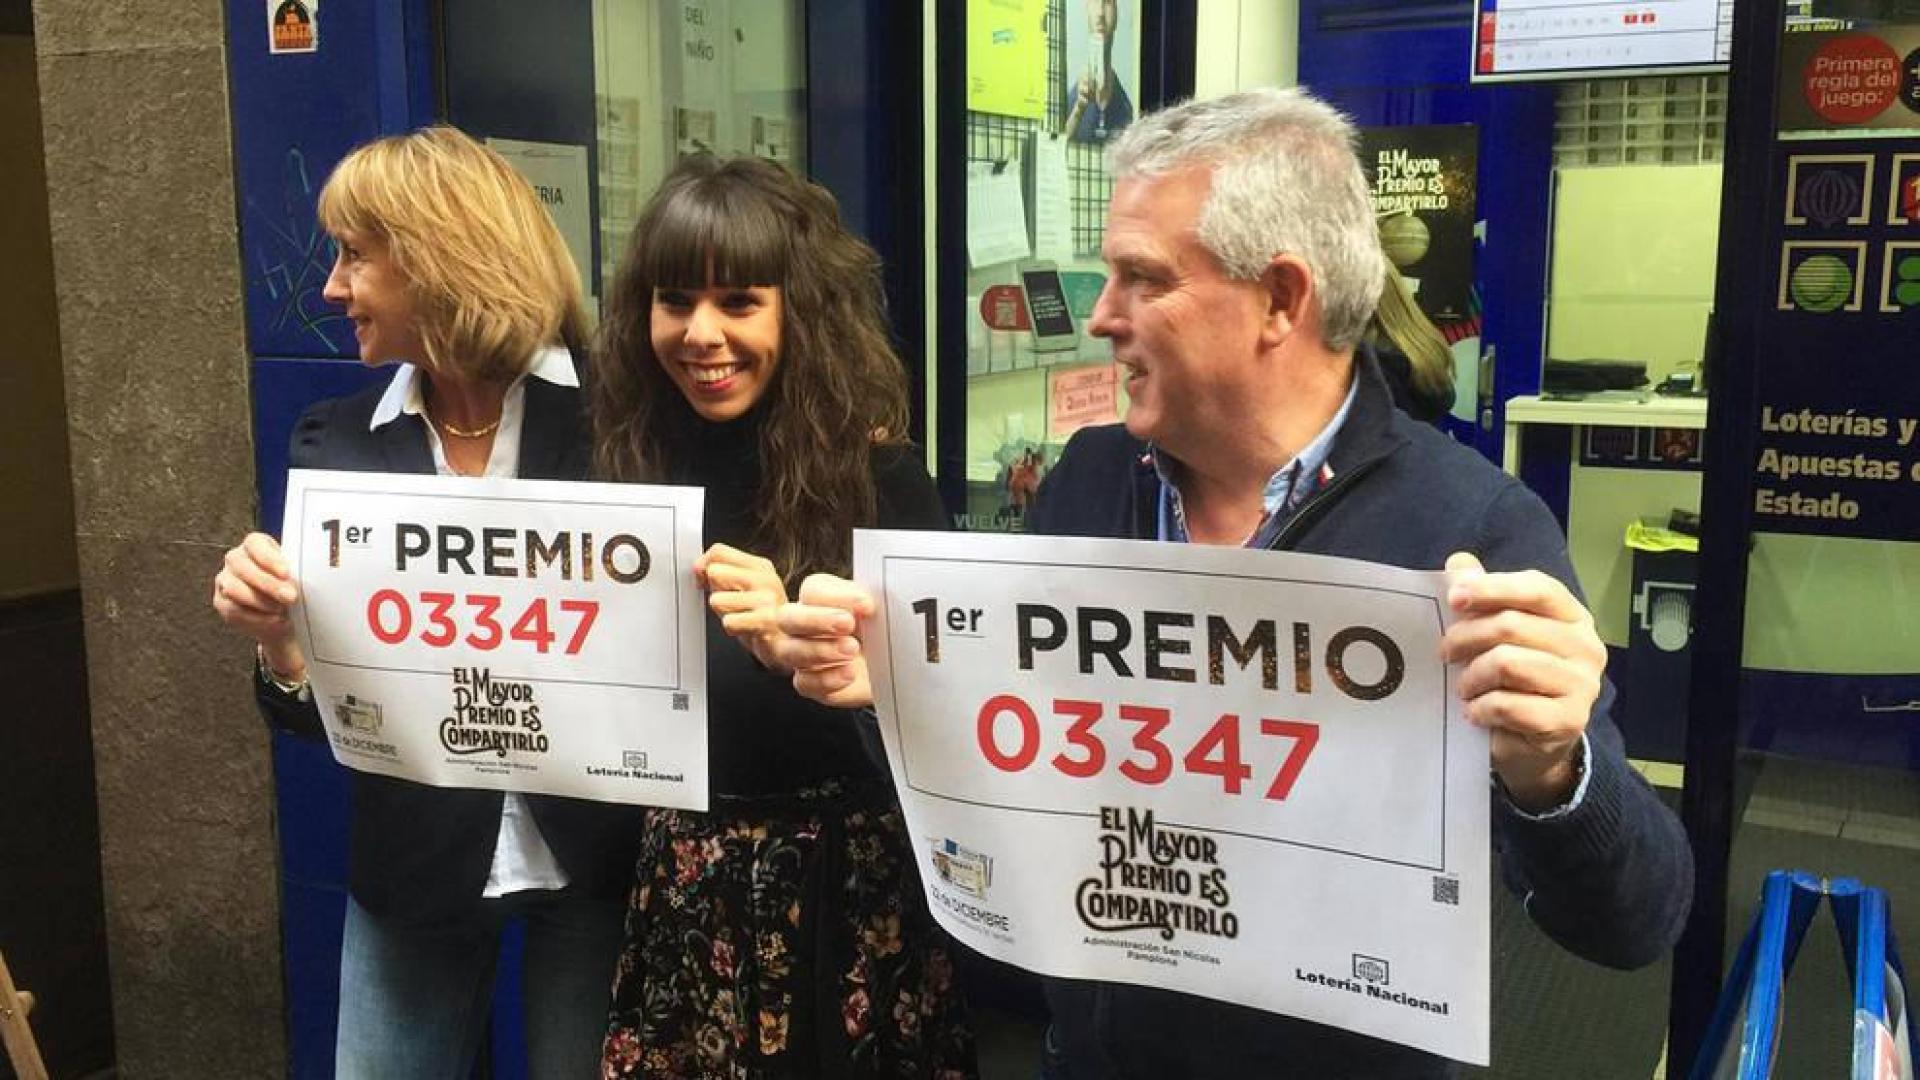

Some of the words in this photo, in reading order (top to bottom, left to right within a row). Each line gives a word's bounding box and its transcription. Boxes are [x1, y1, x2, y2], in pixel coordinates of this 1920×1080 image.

[1809, 71, 1859, 92] regla
[1864, 70, 1898, 88] del
[1816, 55, 1893, 72] Primera
[1819, 91, 1884, 108] juego:
[1368, 189, 1449, 217] OMPARTIRLO
[1762, 406, 1888, 437] Loterías
[1897, 418, 1917, 445] y
[1757, 449, 1900, 480] Apuestas
[953, 513, 1022, 531] VUELVE
[1755, 488, 1859, 520] Estado
[321, 519, 373, 568] 1er
[395, 522, 652, 585] PREMIO
[367, 588, 600, 656] 03347
[912, 597, 985, 664] 1er
[1016, 602, 1406, 701] PREMIO
[452, 667, 471, 684] EL
[472, 667, 533, 707] MAYOR
[453, 686, 516, 726] PREMIO
[521, 705, 541, 732] ES
[439, 717, 548, 758] COMPARTIRLO
[976, 694, 1321, 800] 03347
[1100, 806, 1126, 831] EL
[1128, 806, 1218, 866] MAYOR
[1098, 834, 1191, 895] PREMIO
[1199, 868, 1230, 907] ES
[1076, 878, 1239, 941] COMPARTIRLO
[1366, 984, 1449, 1015] Nacional
